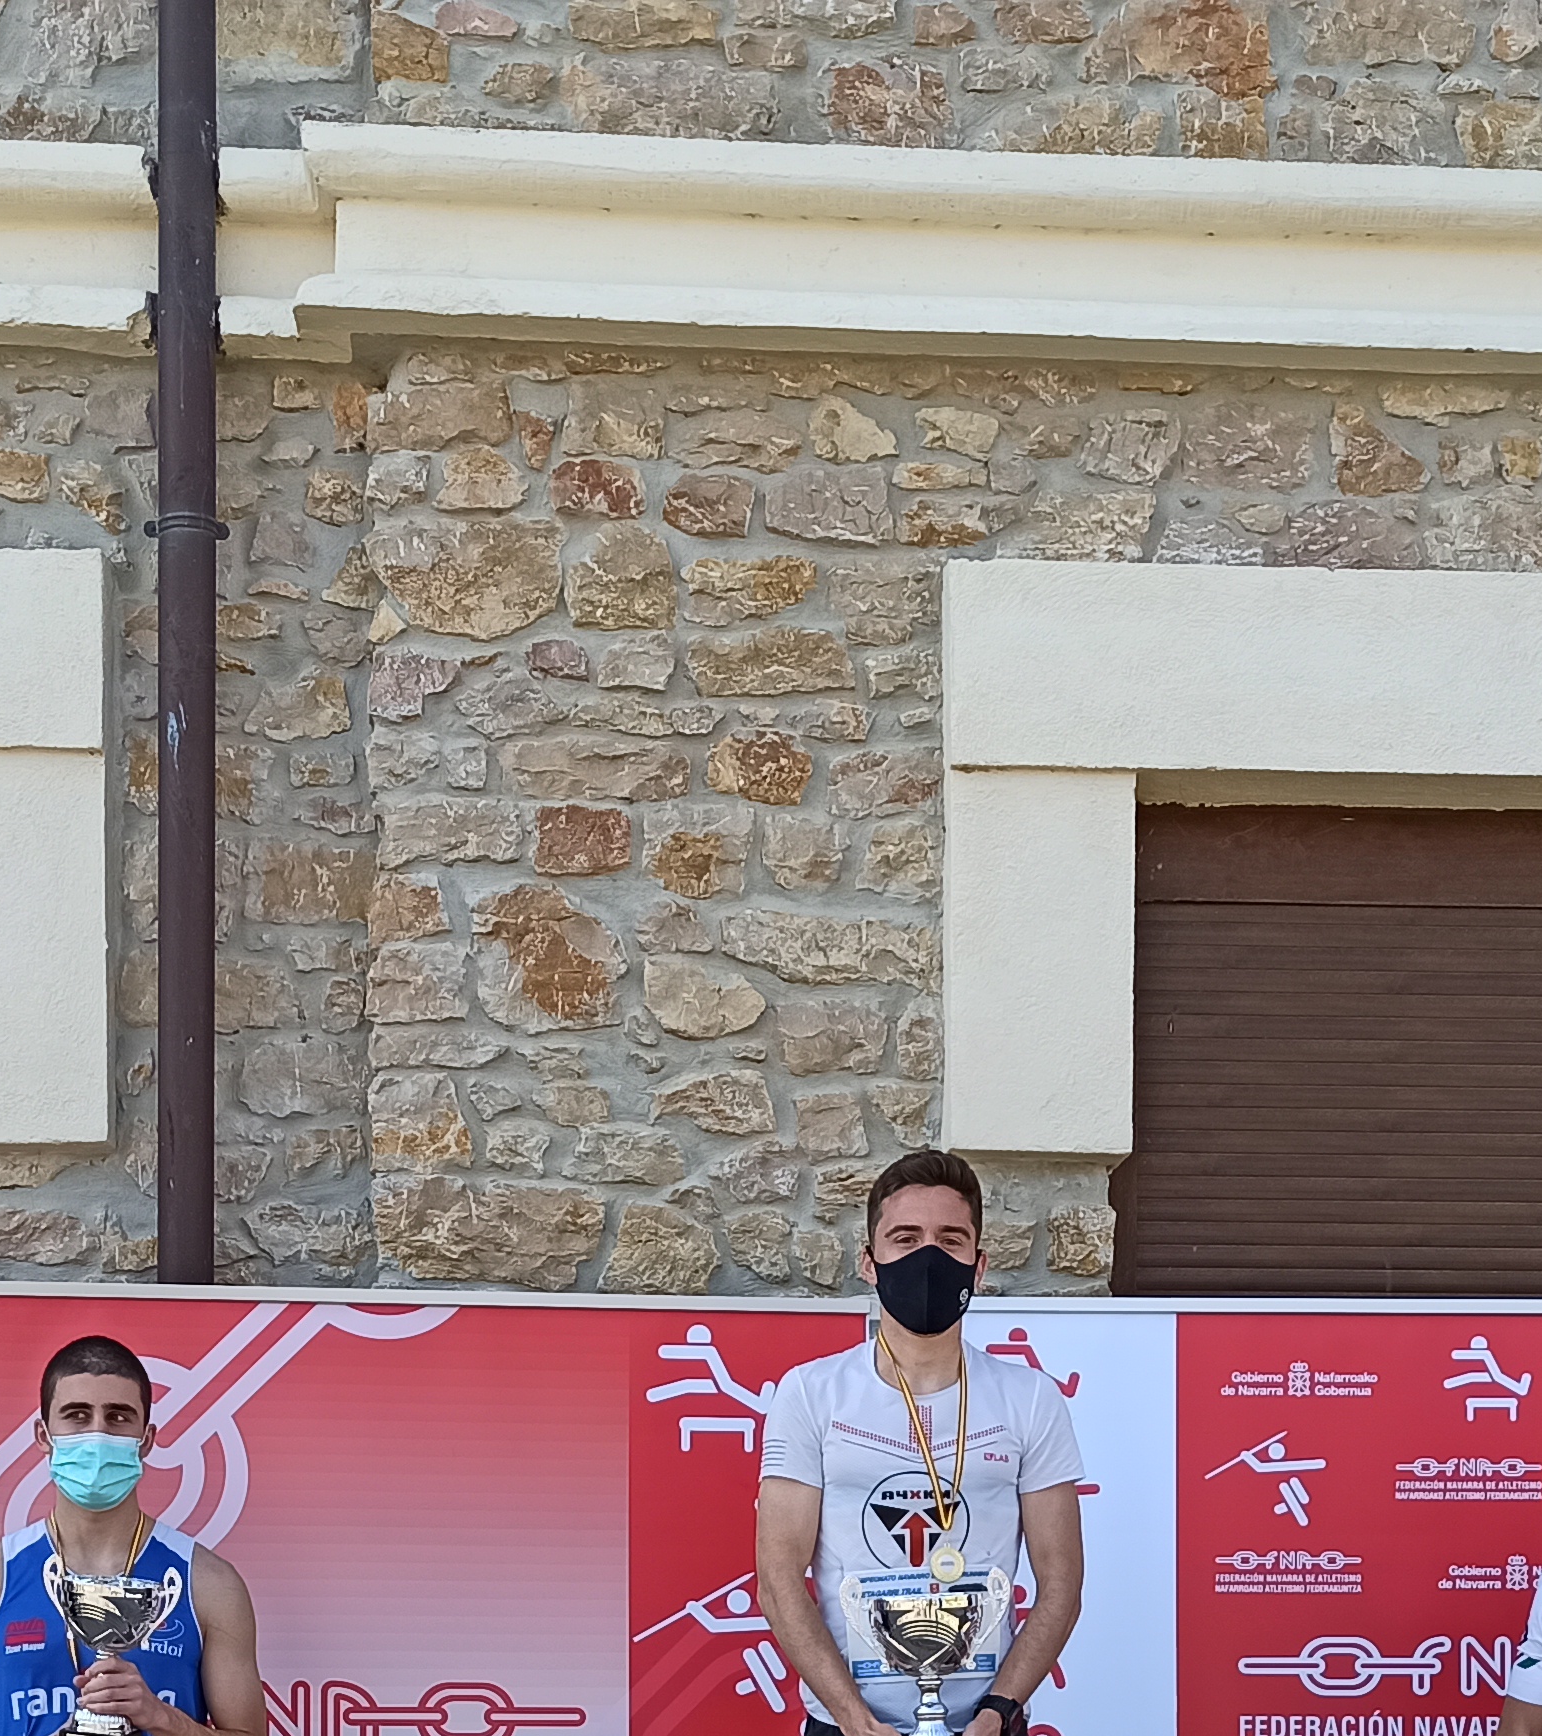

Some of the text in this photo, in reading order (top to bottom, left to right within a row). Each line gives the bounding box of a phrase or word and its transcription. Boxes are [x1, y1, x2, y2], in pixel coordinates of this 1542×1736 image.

[1231, 1371, 1284, 1383] Gobierno
[1314, 1371, 1379, 1383] Nafarroako
[1220, 1385, 1284, 1396] de Navarra
[1314, 1385, 1372, 1396] Gobernua
[1395, 1479, 1542, 1489] FEDERACIÓN NAVARRA DE ATLETISMO
[1395, 1491, 1542, 1500] NAFARROAKO ATLETISMO FEDERAKUNTZA
[1449, 1565, 1501, 1576] Gobierno
[1215, 1572, 1362, 1582] FEDERACIÓN NAVARRA DE ATLETISMO
[1215, 1584, 1362, 1593] NAFARROAKO ATLETISMO FEDERAKUNTZA
[1438, 1578, 1501, 1589] de Navarra
